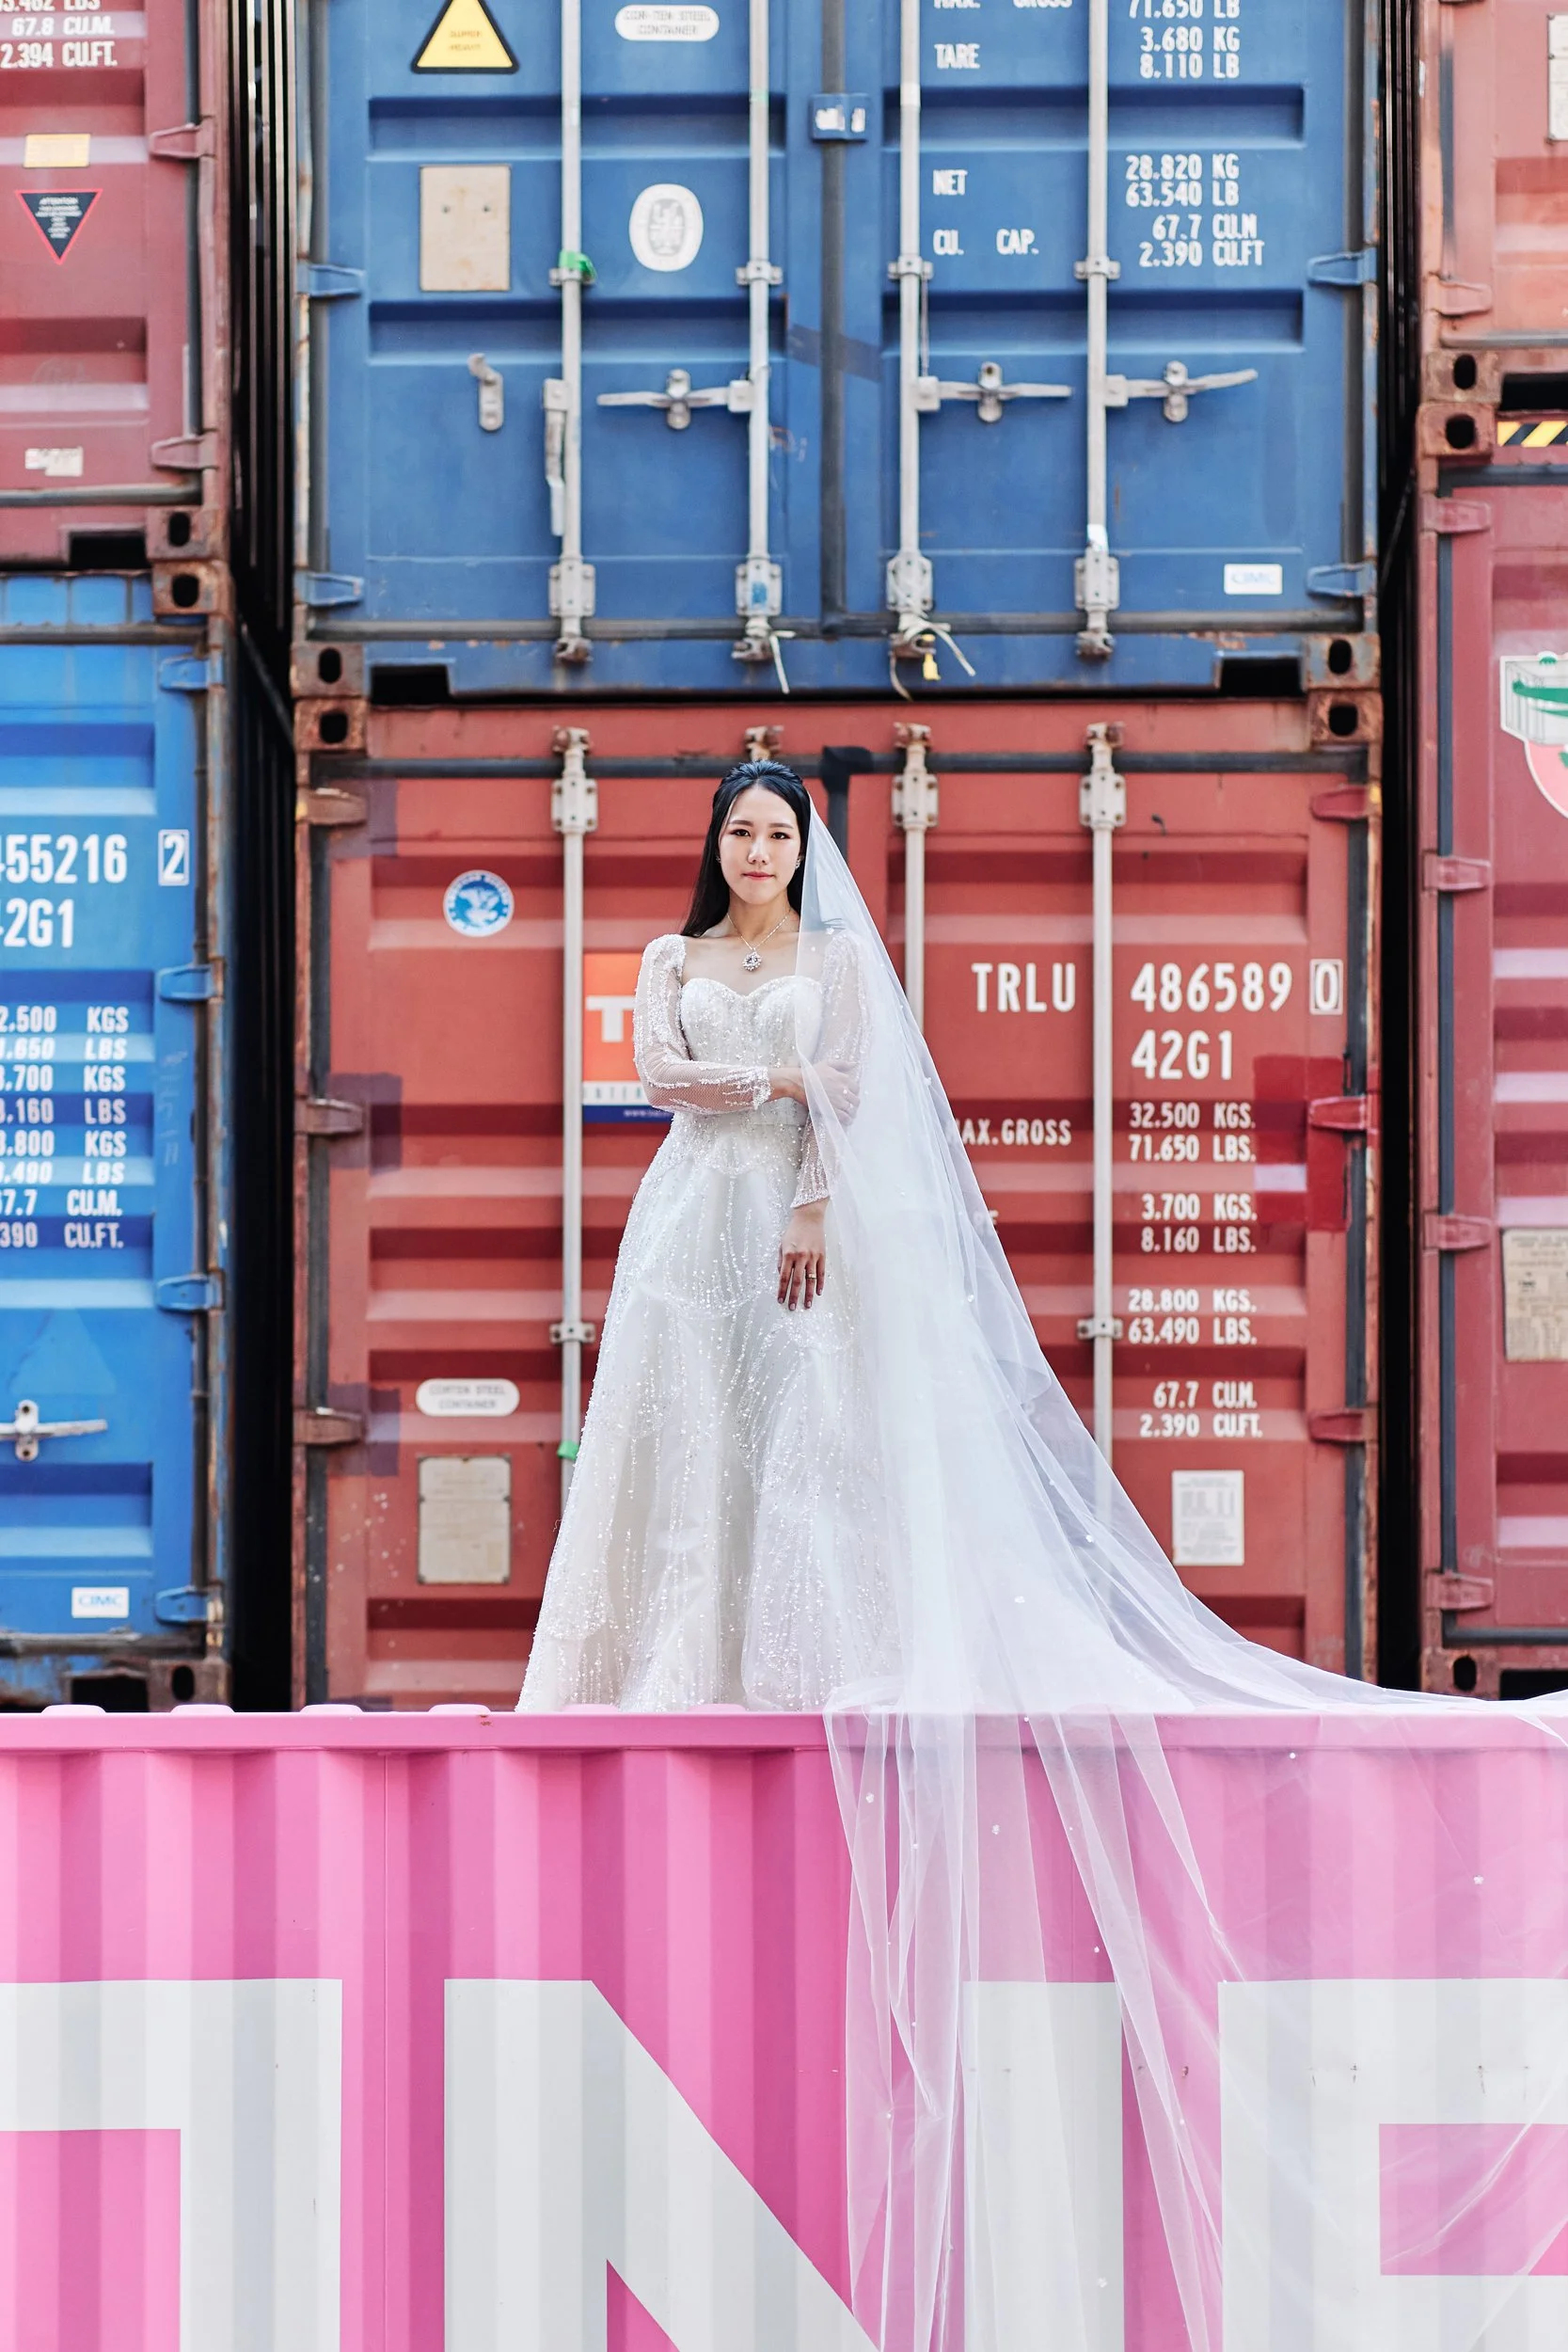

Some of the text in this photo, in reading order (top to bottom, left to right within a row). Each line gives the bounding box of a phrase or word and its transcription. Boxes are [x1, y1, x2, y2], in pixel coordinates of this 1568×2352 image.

[1129, 0, 1240, 18] 71.650 LB
[12, 17, 55, 37] 67.8
[1140, 26, 1240, 52] 3.680 KG
[0, 41, 55, 69] 2.394
[934, 43, 981, 69] TARE
[1140, 53, 1240, 79] 8.110 LB
[1126, 153, 1240, 181] 28.820 KG
[932, 169, 968, 196] NET
[1126, 181, 1240, 207] 63.540 LB
[1151, 214, 1202, 240] 67.7
[996, 229, 1039, 256] CAP.
[1139, 241, 1202, 267] 2.390
[0, 834, 186, 883] 55216 2
[0, 898, 74, 948] 2G1
[971, 962, 1076, 1012] TRLU
[1130, 962, 1293, 1013] 486589
[87, 1006, 129, 1033] KGS
[85, 1037, 127, 1061] LBS
[1131, 1029, 1233, 1081] 42G1
[84, 1065, 126, 1092] KGS
[85, 1098, 126, 1124] LBS
[1130, 1102, 1257, 1129] 32.500 KGS.
[85, 1130, 127, 1157] KGS
[951, 1118, 1072, 1147] AX.GROSS
[1130, 1134, 1257, 1162] 71.650 LBS.
[82, 1161, 125, 1185] LBS
[0, 1188, 123, 1216] 7.7 CU.M.
[1141, 1193, 1258, 1221] 3.700 KGS.
[64, 1222, 124, 1248] CU.FT.
[1141, 1226, 1257, 1253] 8.160 LBS.
[1129, 1288, 1257, 1312] 28.800 KGS.
[1129, 1317, 1257, 1344] 63.490 LBS.
[1153, 1381, 1258, 1408] 67.7 CU.M.
[1140, 1413, 1263, 1438] 2.390 CU.FT.
